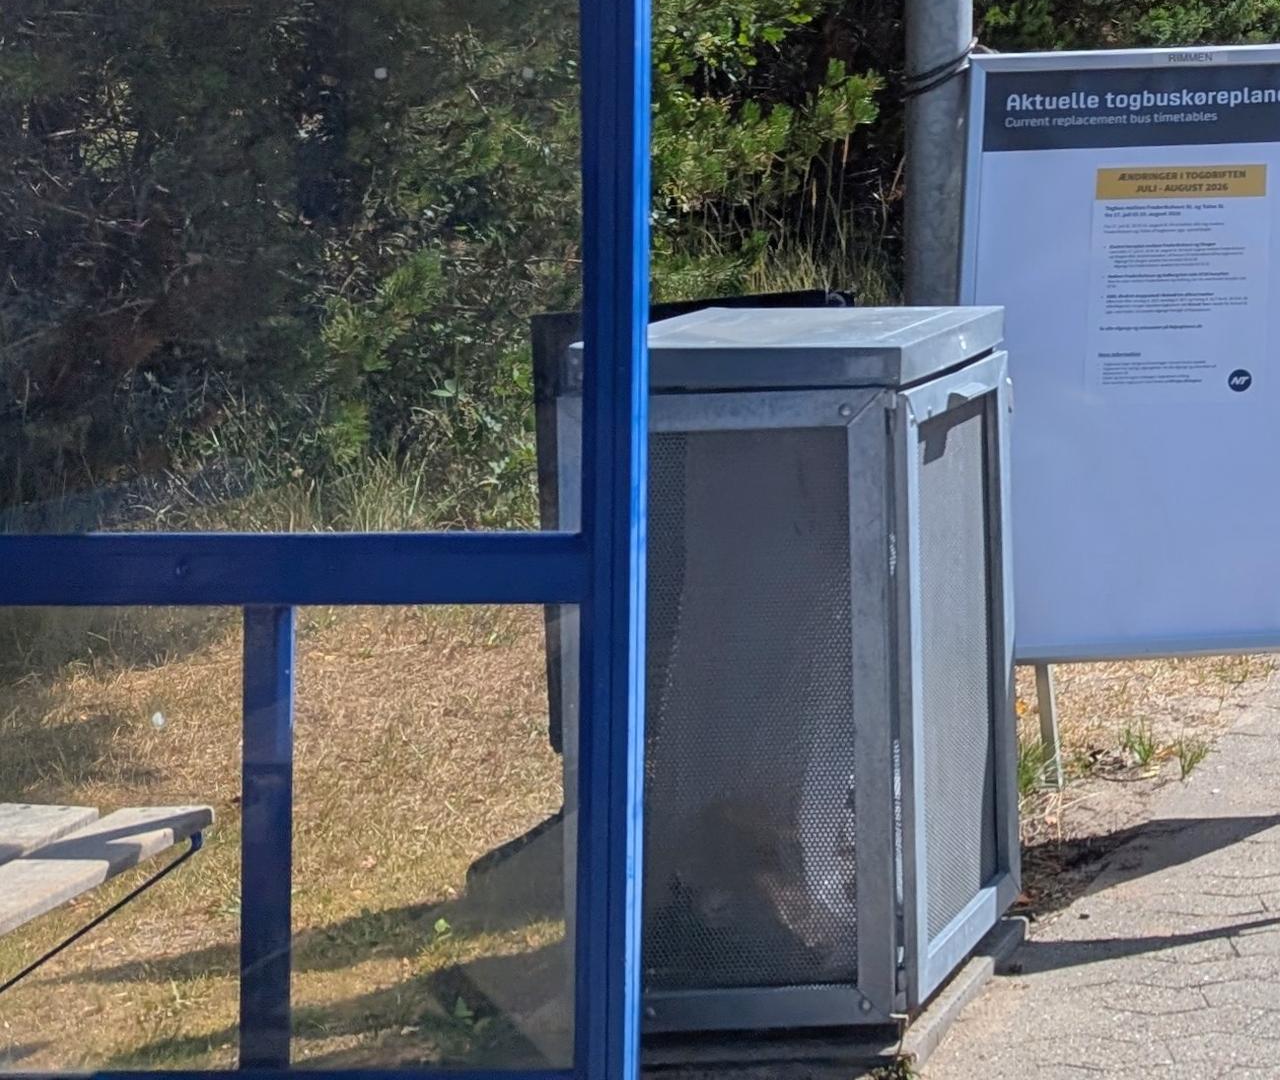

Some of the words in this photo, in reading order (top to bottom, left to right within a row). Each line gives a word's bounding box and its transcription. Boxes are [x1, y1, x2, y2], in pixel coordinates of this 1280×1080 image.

[1168, 52, 1213, 63] RIMMEN
[1006, 92, 1100, 111] Aktuelle
[1005, 116, 1050, 128] Current
[1052, 114, 1128, 127] replacement
[1129, 113, 1152, 124] bus
[1153, 110, 1218, 123] timetables
[1118, 172, 1178, 181] ÆNDRINGER
[1136, 184, 1158, 193] JULI
[1164, 183, 1204, 192] AUGUST
[1230, 376, 1249, 385] NT
